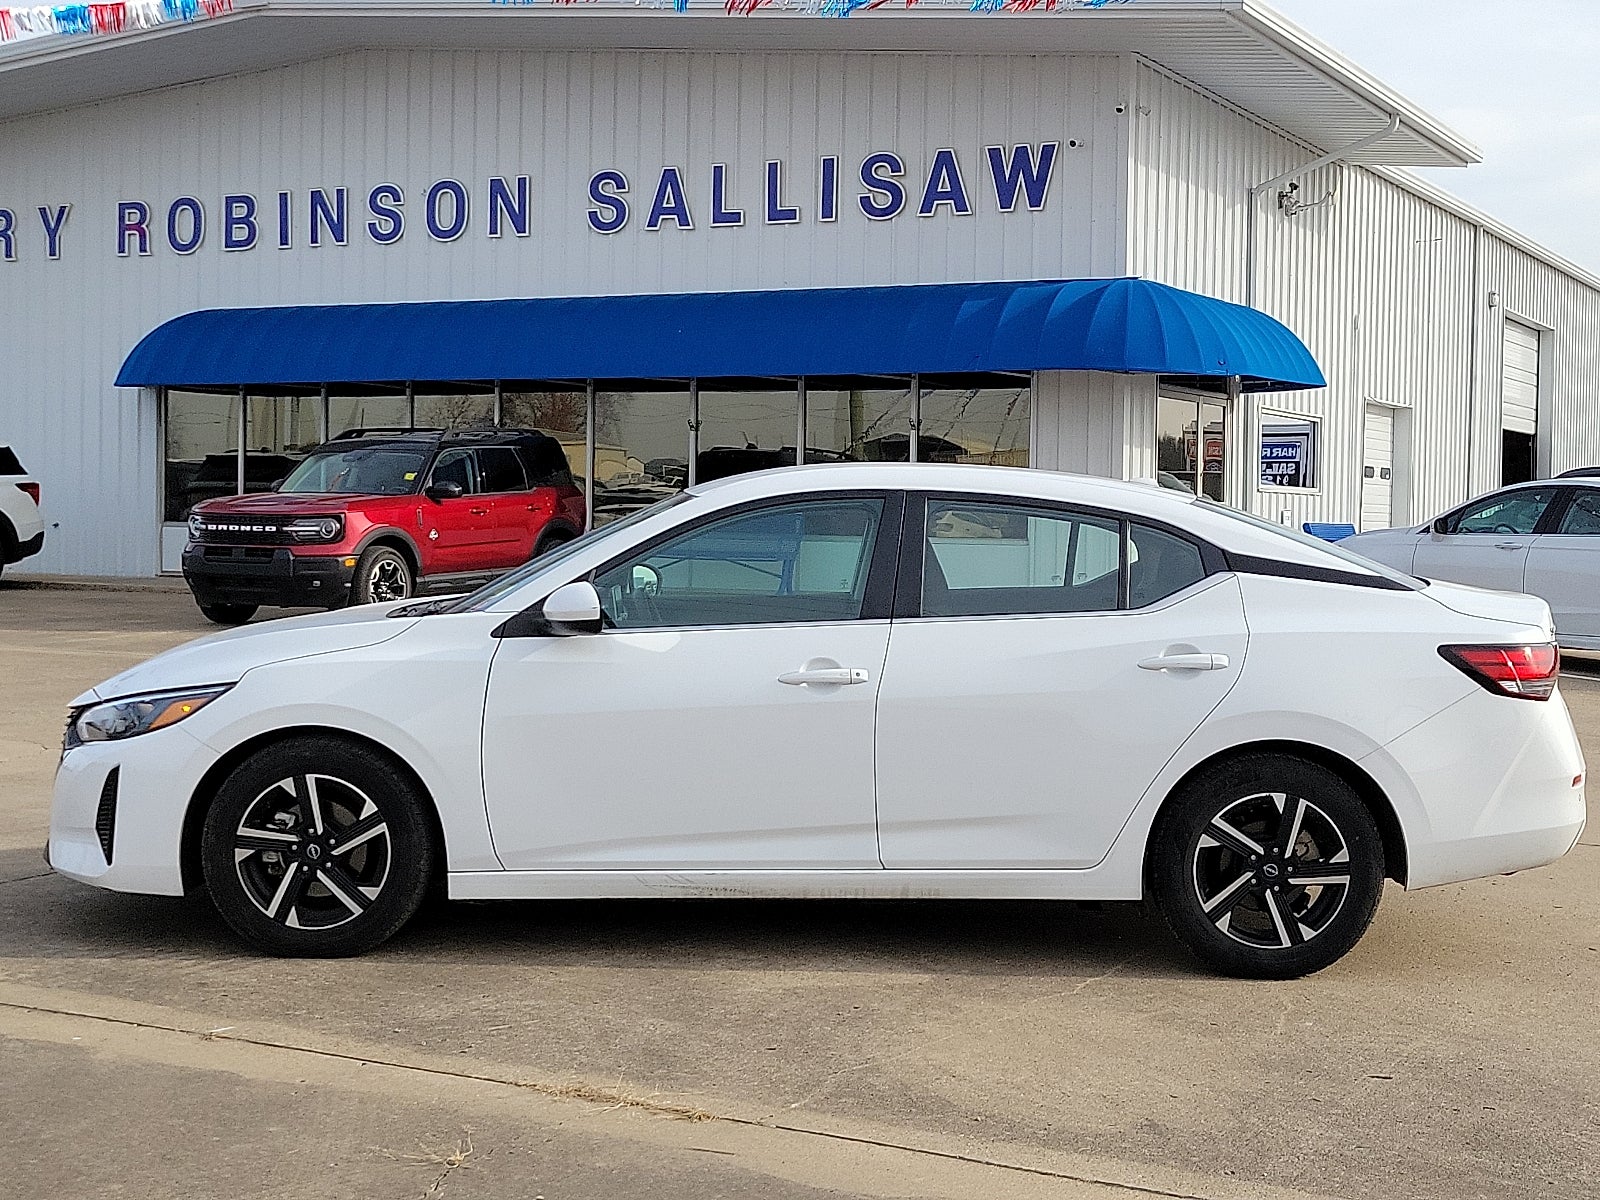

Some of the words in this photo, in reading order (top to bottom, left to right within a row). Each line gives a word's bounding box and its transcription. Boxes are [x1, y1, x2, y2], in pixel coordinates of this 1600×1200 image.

[117, 173, 532, 257] ROBINSON
[586, 141, 1059, 234] SALLISAW
[207, 524, 277, 532] BRONCO
